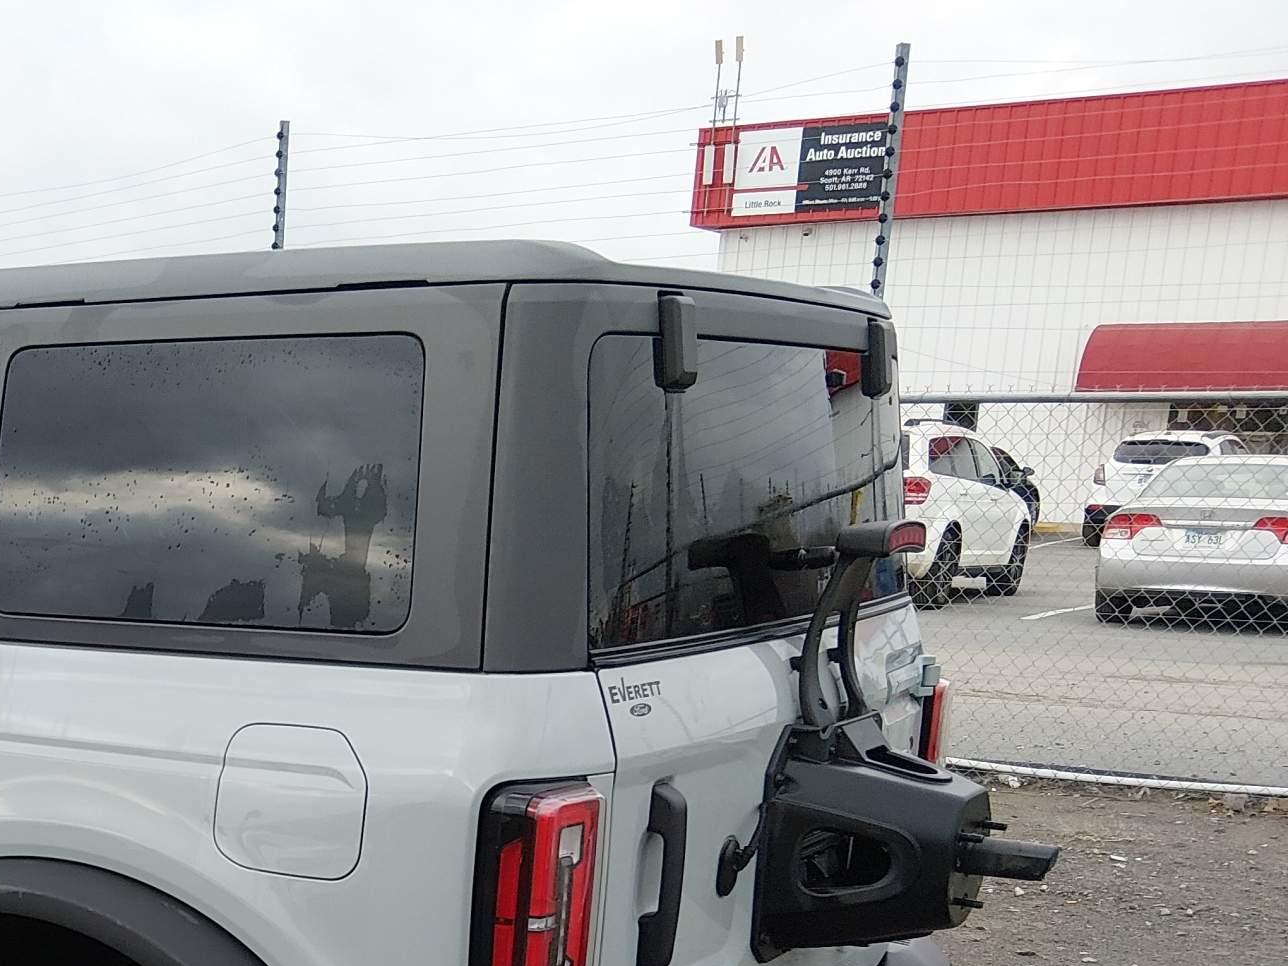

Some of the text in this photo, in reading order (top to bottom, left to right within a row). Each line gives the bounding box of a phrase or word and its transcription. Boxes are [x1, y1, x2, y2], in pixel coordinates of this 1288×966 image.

[820, 130, 882, 145] Insurance
[806, 144, 887, 162] Auto Auction
[744, 199, 782, 209] Little Rock
[608, 677, 661, 704] EVERETT
